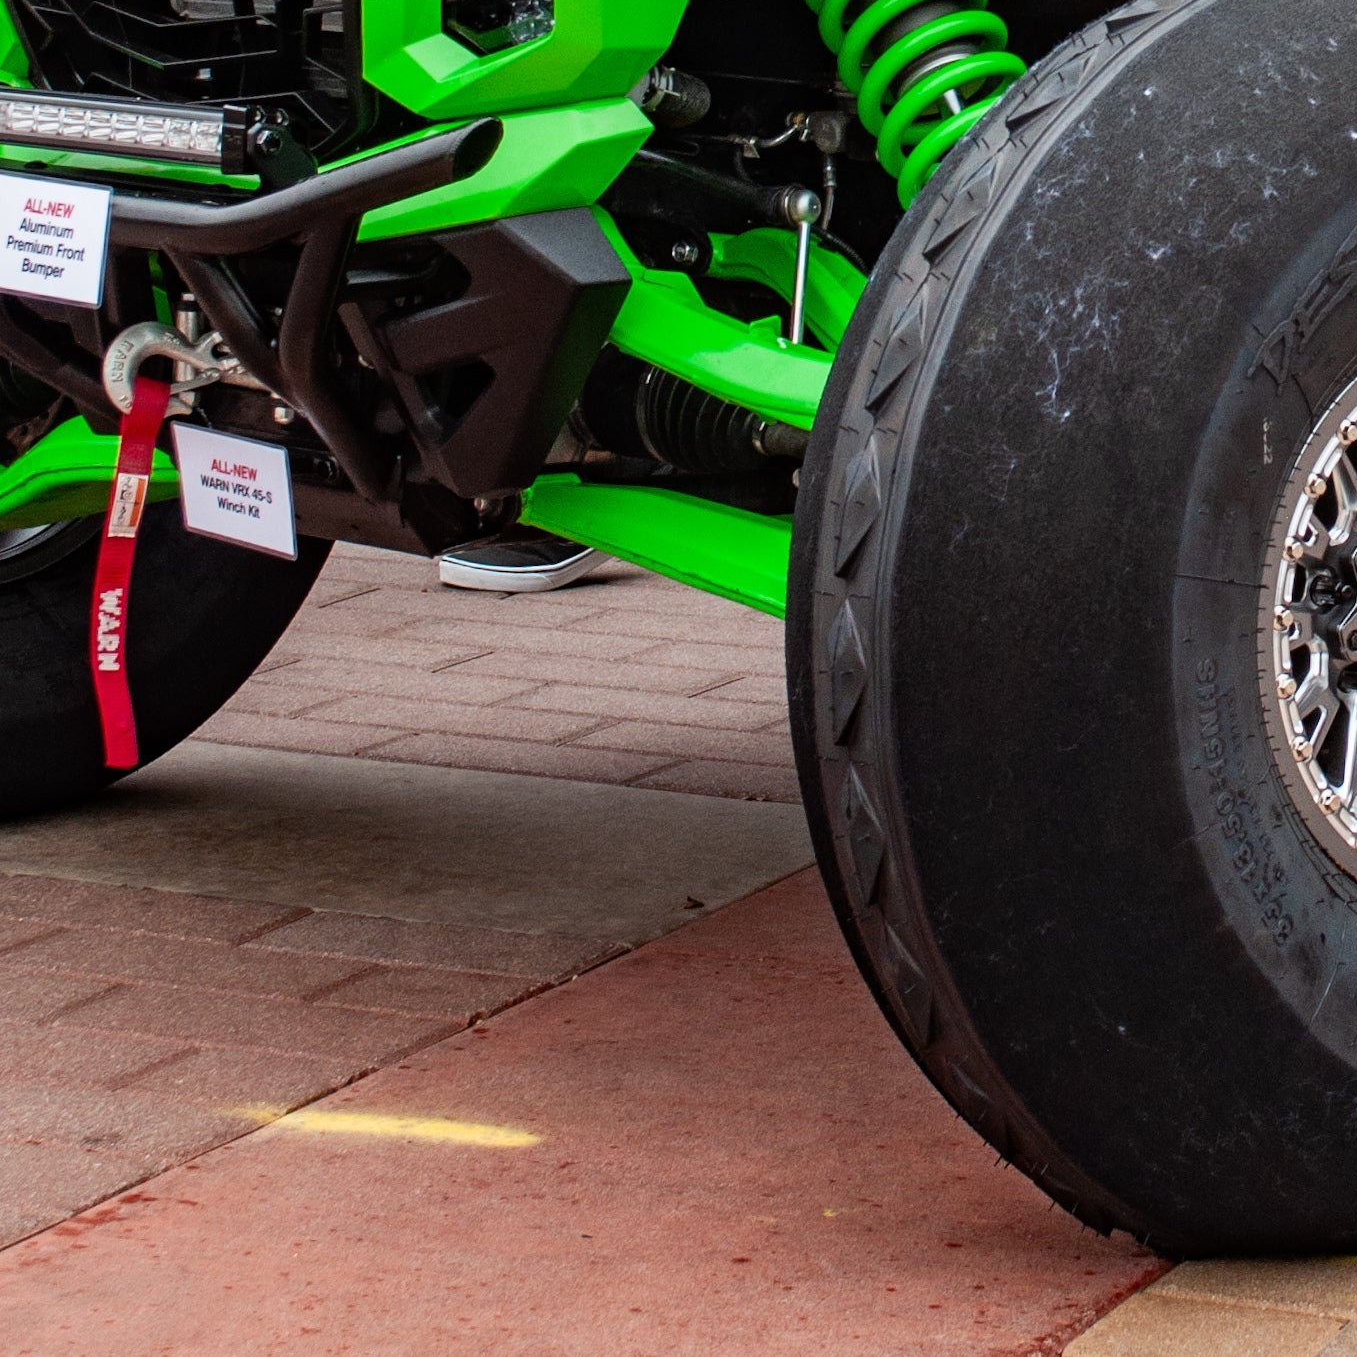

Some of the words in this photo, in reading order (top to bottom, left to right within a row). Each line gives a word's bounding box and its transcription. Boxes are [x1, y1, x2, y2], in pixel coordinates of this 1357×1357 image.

[23, 198, 75, 219] ALL-NEW
[18, 217, 74, 240] Aluminum
[6, 235, 54, 257] Premium
[55, 243, 86, 262] Front
[21, 257, 65, 280] Bumper
[211, 458, 258, 482] ALL-NEW
[200, 473, 230, 493] WARN
[231, 482, 250, 498] VRX
[251, 489, 273, 505] 45-S
[217, 495, 247, 516] Winch
[248, 504, 261, 519] Kit
[98, 588, 123, 671] WARN
